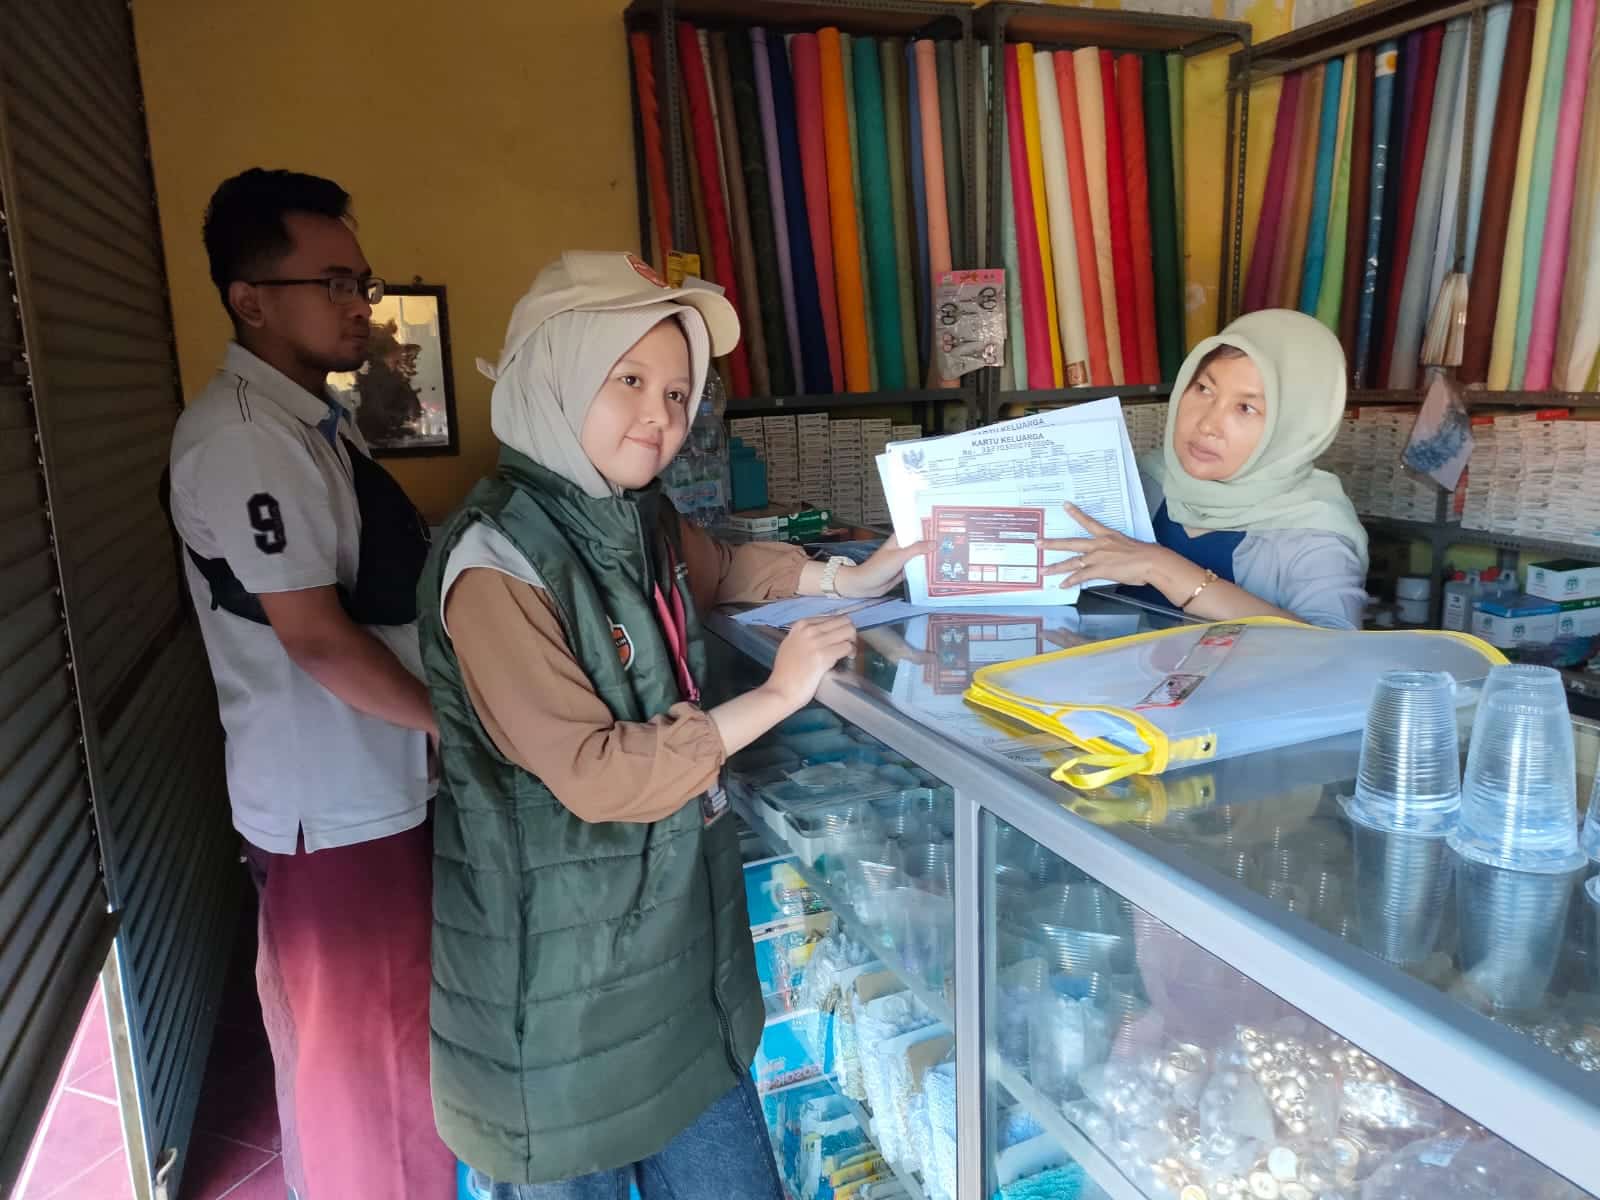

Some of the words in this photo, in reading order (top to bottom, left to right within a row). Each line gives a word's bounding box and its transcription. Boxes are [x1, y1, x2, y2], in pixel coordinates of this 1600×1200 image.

[971, 437, 999, 448] KARTU
[1001, 432, 1045, 444] KELUARGA
[247, 492, 287, 555] 9
